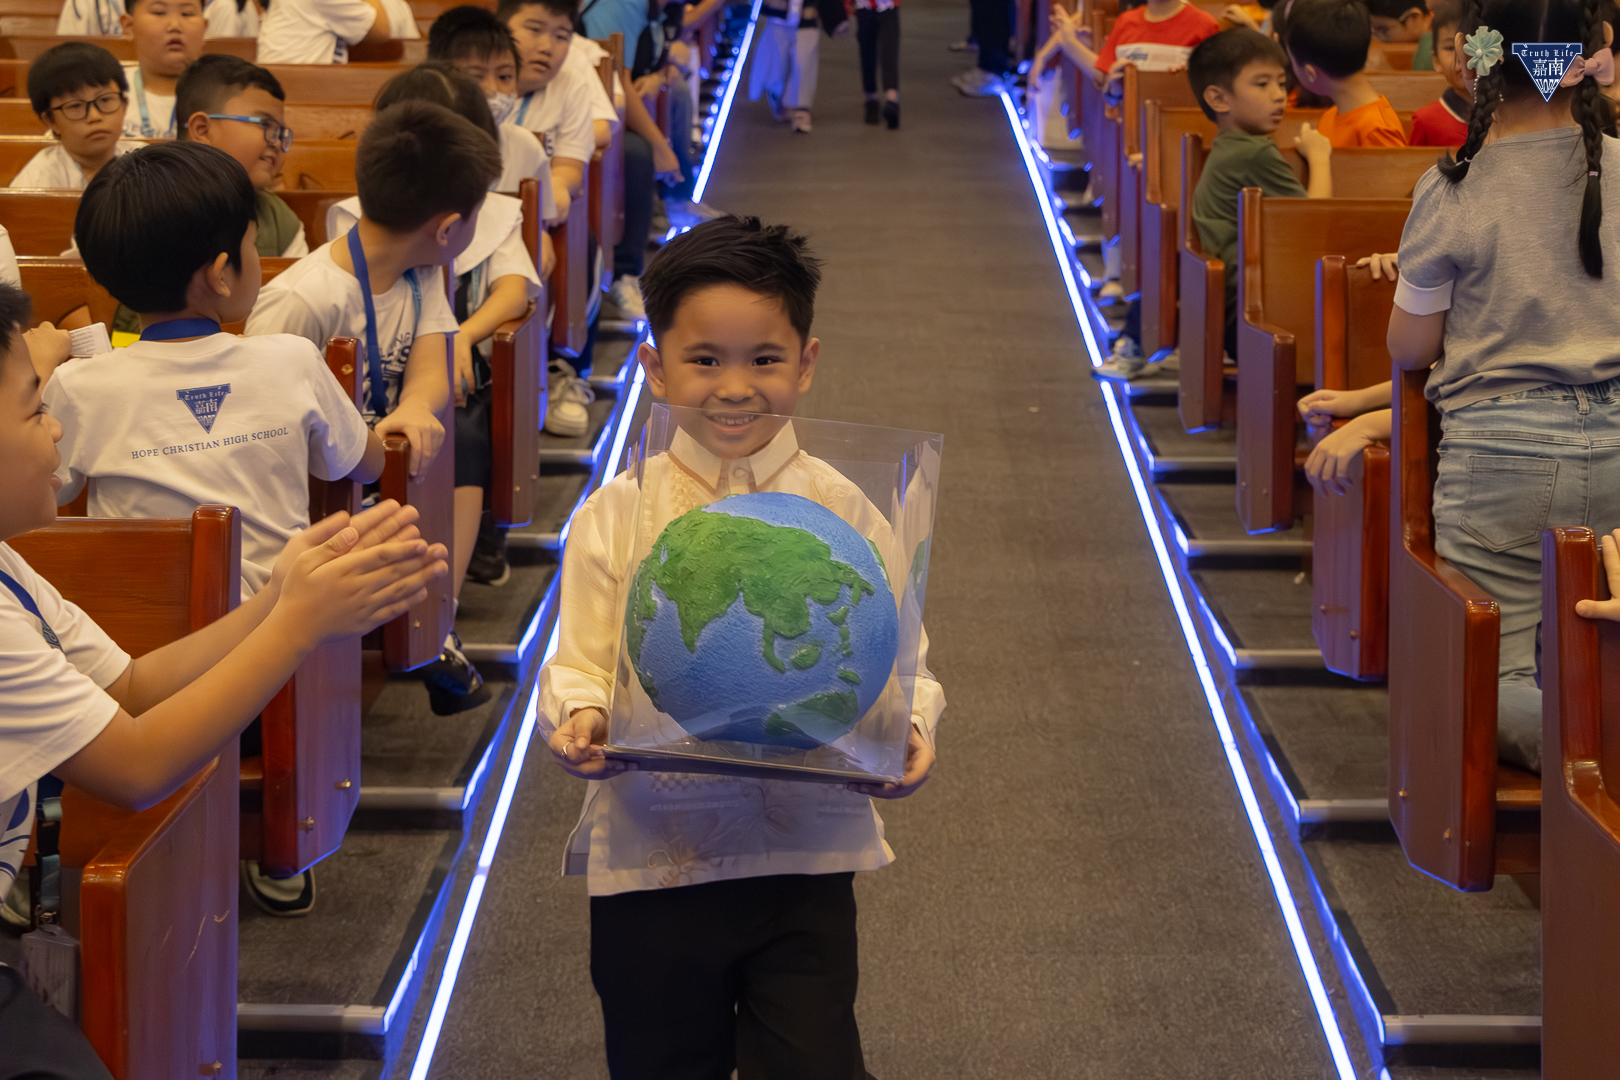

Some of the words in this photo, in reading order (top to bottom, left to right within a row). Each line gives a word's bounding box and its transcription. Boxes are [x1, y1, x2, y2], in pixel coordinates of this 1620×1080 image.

[184, 393, 207, 401] Truth
[209, 390, 224, 398] Life
[131, 448, 159, 459] HOPE
[162, 439, 220, 456] CHRISTIAN
[222, 434, 249, 446] HIGH
[250, 426, 289, 441] SCHOOL
